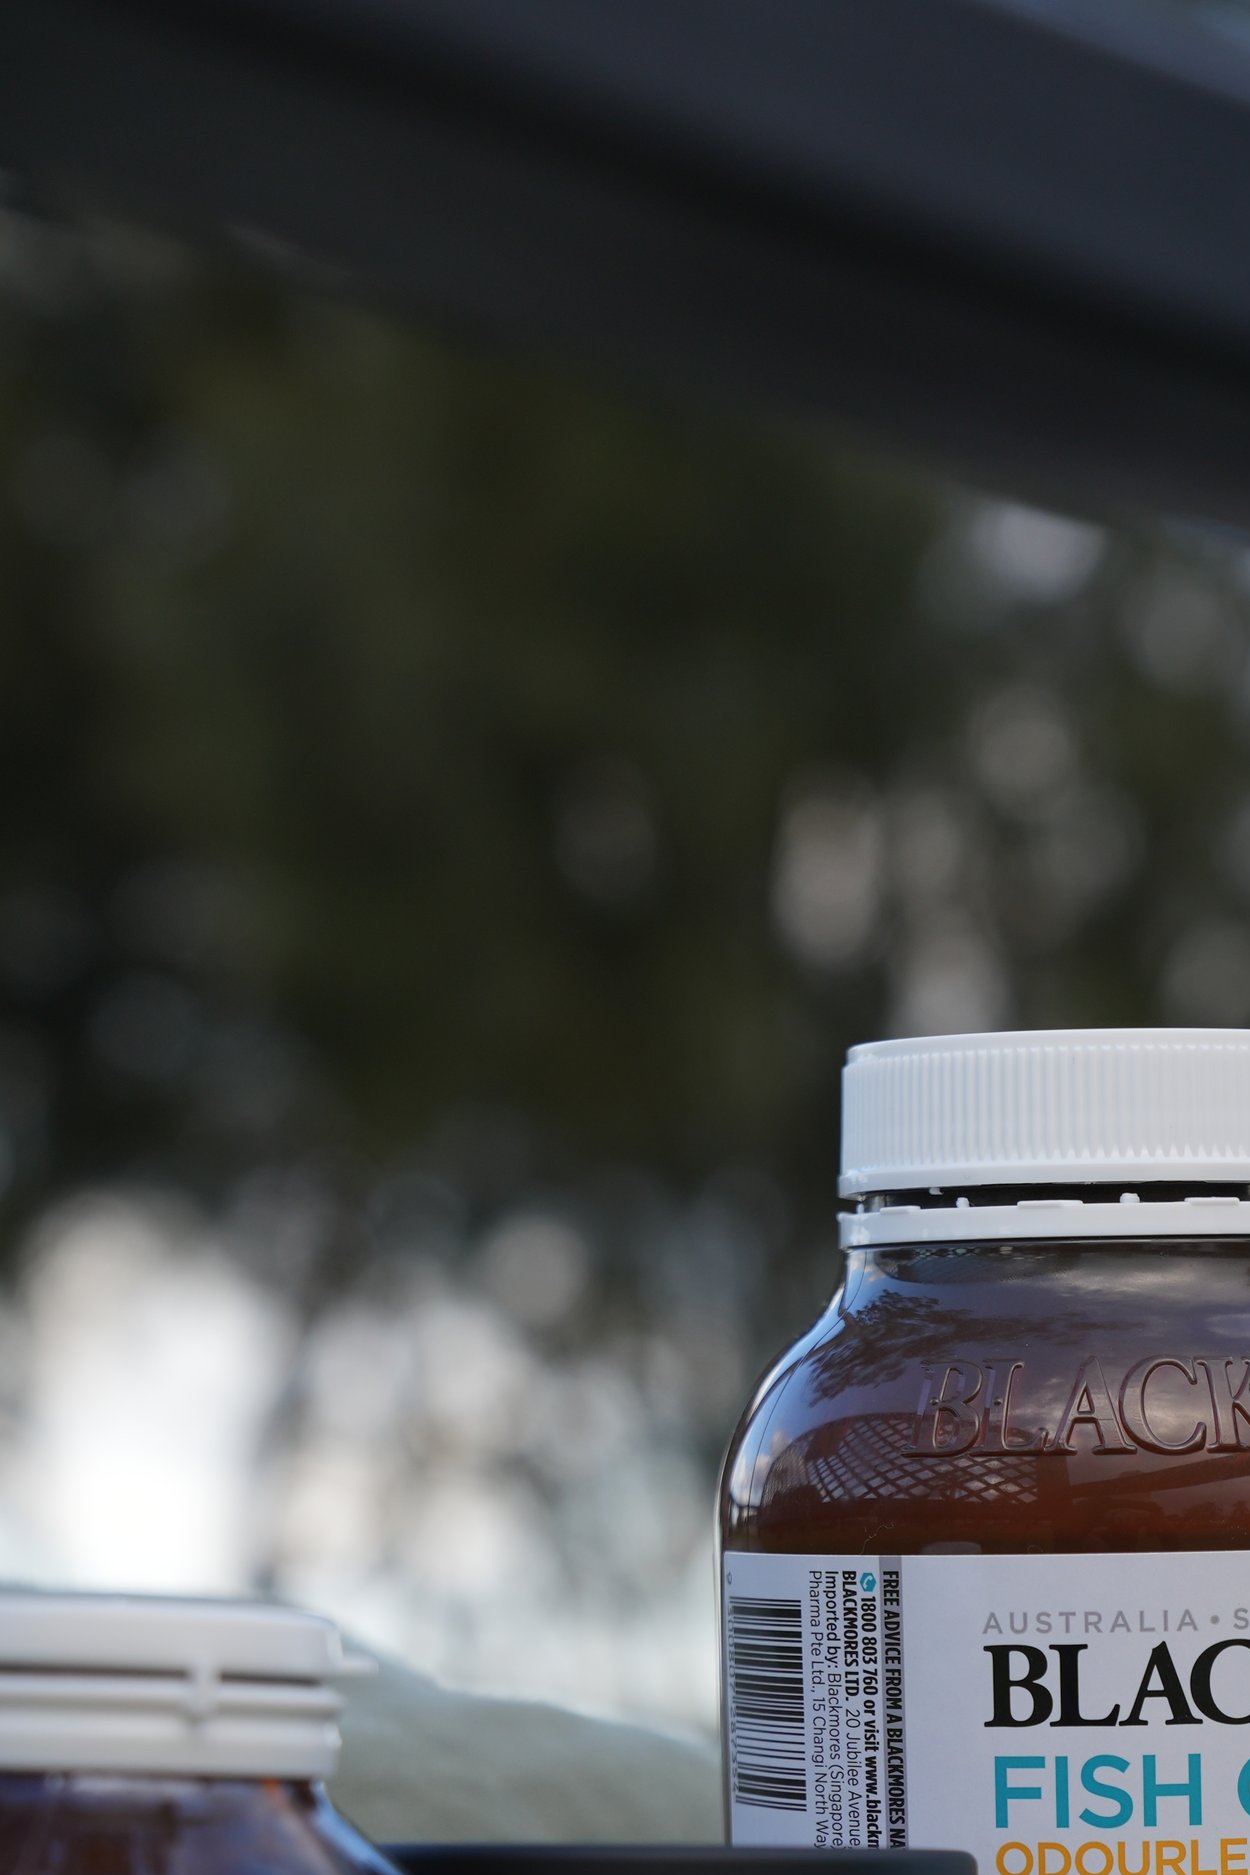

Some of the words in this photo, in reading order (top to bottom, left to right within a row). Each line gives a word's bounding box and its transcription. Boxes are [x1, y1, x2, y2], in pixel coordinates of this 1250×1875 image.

[809, 1571, 822, 1627] Pharma
[883, 1571, 900, 1606] FREE
[824, 1571, 840, 1642] Imported
[842, 1570, 858, 1667] BLACKMORES
[861, 1596, 876, 1632] 1800
[982, 1609, 1198, 1634] AUSTRALIA
[810, 1632, 823, 1656] Pte
[863, 1637, 877, 1664] 803
[884, 1610, 901, 1664] ADVICE
[826, 1646, 840, 1668] by:
[811, 1661, 825, 1692] Ltd.,
[844, 1671, 859, 1701] LTD.
[863, 1669, 878, 1695] 760
[886, 1669, 902, 1710] FROM
[813, 1697, 825, 1711] 15
[828, 1674, 842, 1759] Blackmores
[846, 1709, 859, 1728] 20
[864, 1700, 875, 1716] or
[887, 1714, 902, 1724] A
[812, 1716, 826, 1767] Changi
[864, 1720, 879, 1752] visit
[846, 1733, 861, 1786] Jubilee
[887, 1728, 905, 1824] BLACKMORES
[815, 1772, 828, 1814] North
[995, 1754, 1202, 1828] FISH
